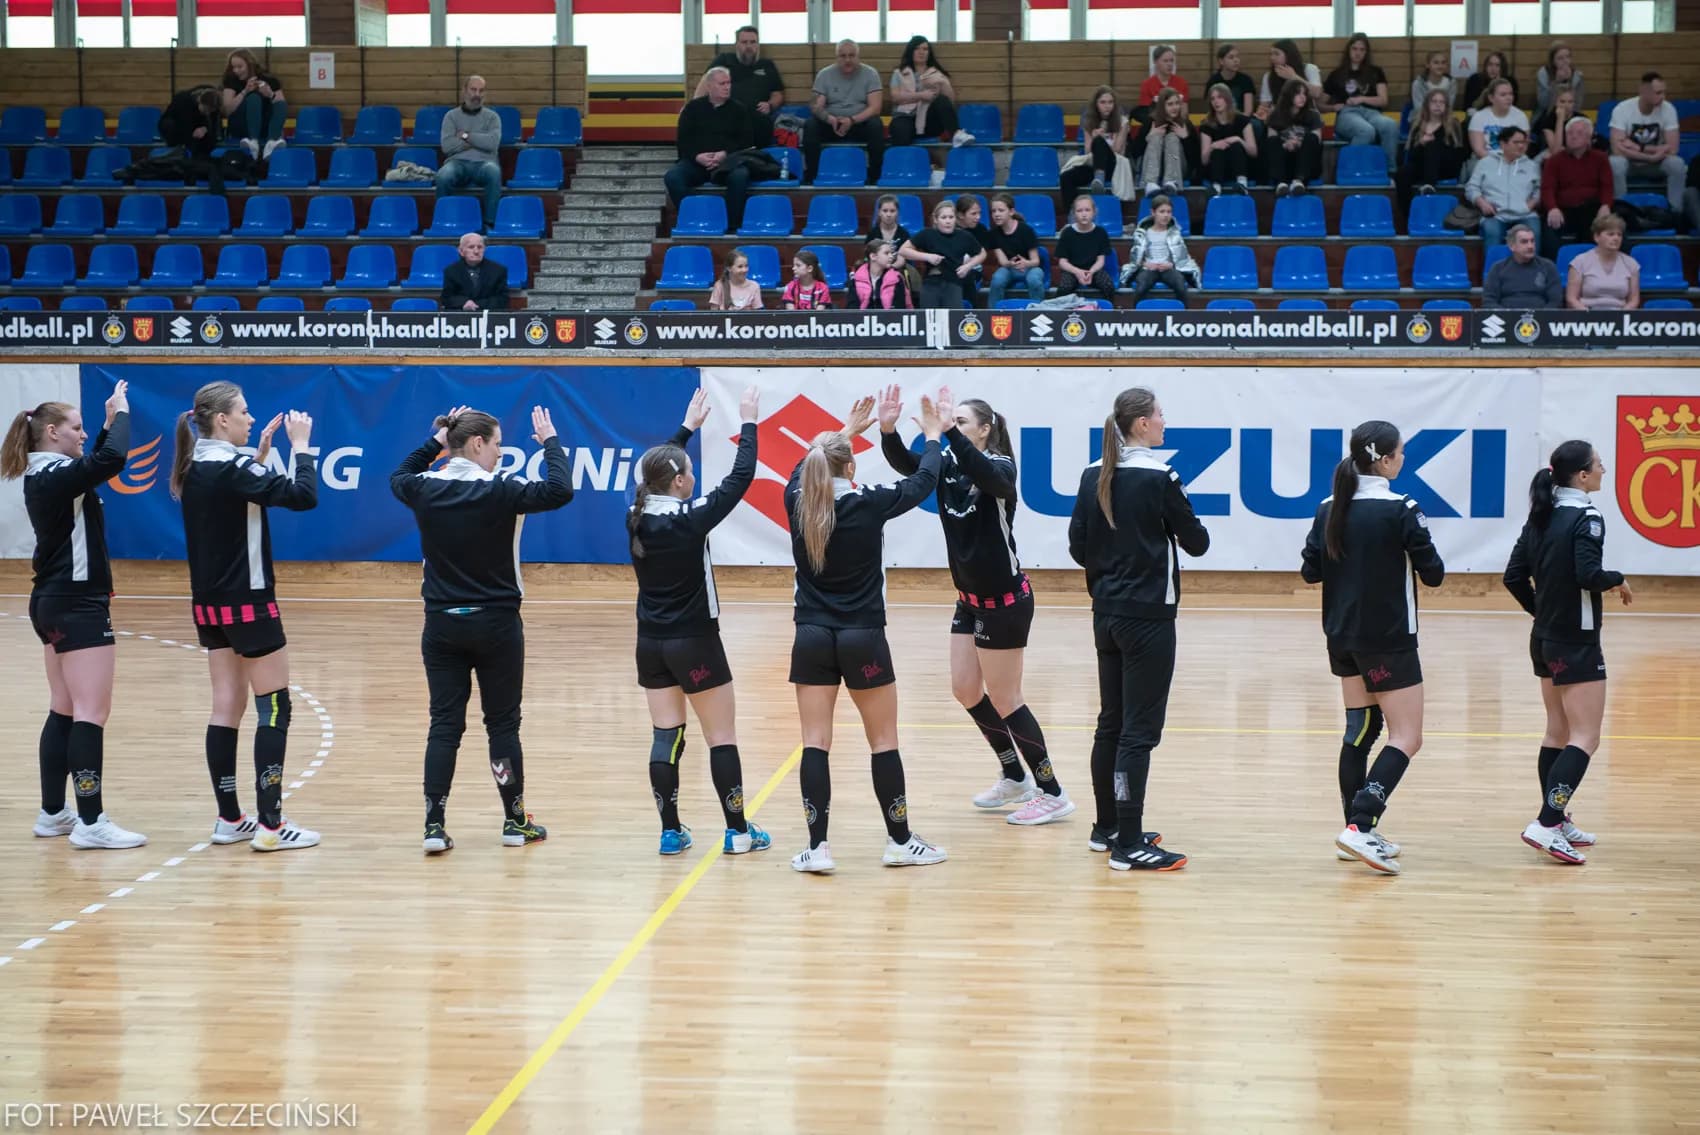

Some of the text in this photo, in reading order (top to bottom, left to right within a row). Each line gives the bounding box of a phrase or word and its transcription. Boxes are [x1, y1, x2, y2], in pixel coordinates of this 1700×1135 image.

[317, 68, 328, 81] B
[0, 316, 93, 345] dball.pl
[656, 315, 936, 341] www.koronahandball.
[1095, 315, 1397, 345] www.koronahandball.pl
[1549, 314, 1700, 337] www.koron
[908, 427, 1506, 518] UZUKI
